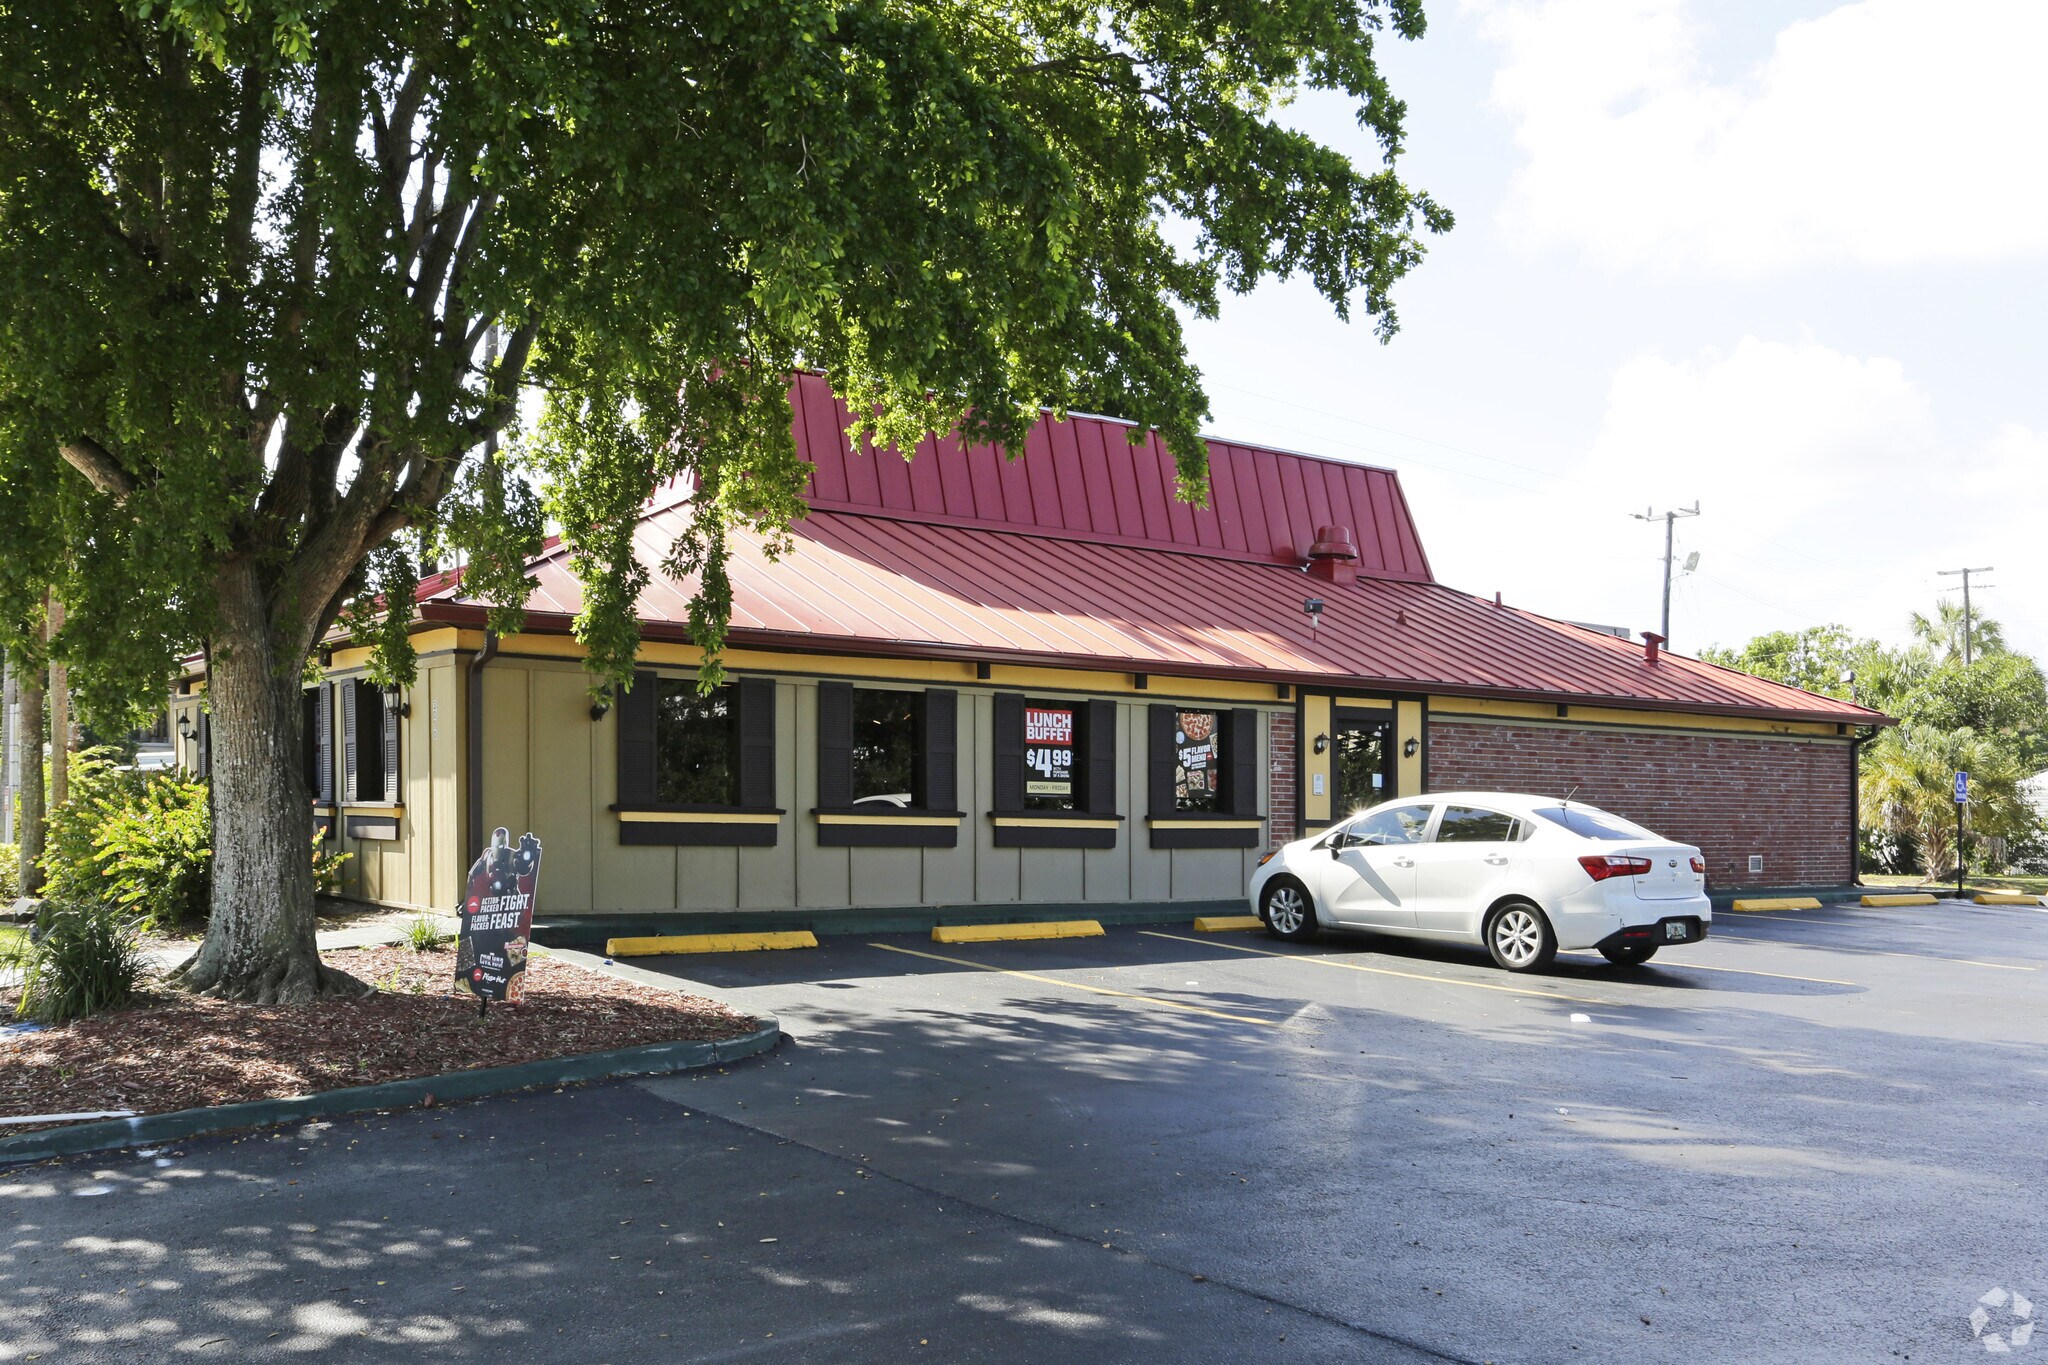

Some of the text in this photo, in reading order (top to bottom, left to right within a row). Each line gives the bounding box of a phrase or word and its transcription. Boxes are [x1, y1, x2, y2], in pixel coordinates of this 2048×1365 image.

[1026, 712, 1071, 728] LUNCH
[1026, 727, 1071, 741] BUFFET
[1178, 747, 1192, 768] $5
[1191, 744, 1210, 755] FLAVOR
[480, 904, 500, 913] PACKED
[470, 921, 490, 931] PACKED
